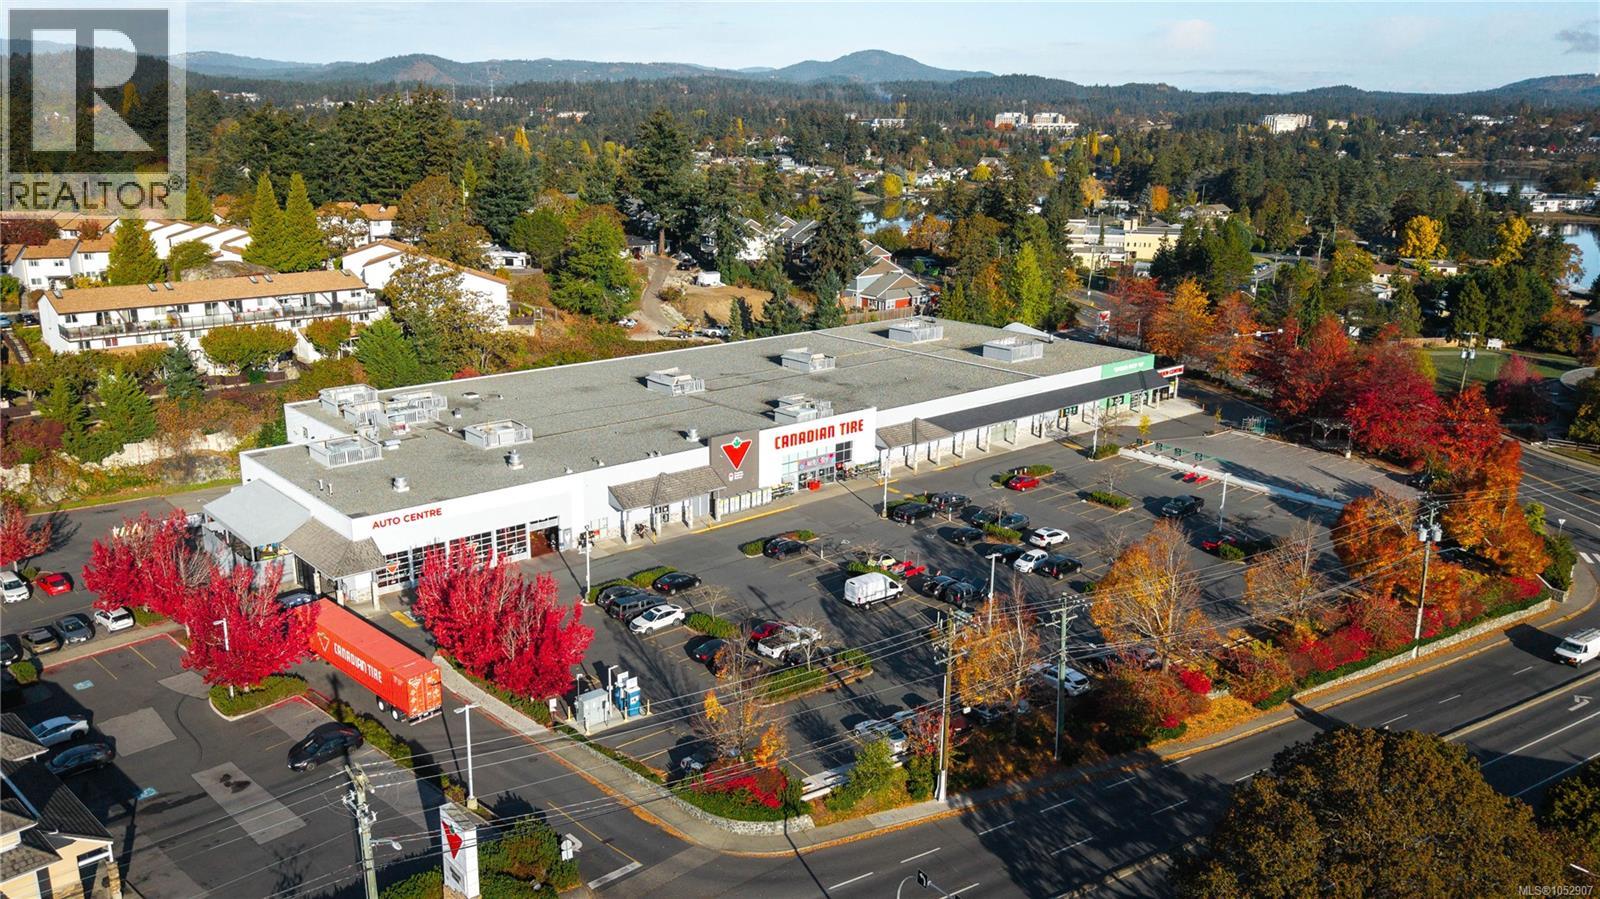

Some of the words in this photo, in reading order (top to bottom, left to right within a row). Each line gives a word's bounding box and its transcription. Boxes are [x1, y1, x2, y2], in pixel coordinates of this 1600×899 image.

[774, 425, 835, 450] CANADIAN
[839, 418, 864, 436] TIRE
[372, 516, 401, 529] AUTO
[403, 507, 442, 523] CENTRE
[333, 642, 367, 674] CANADIAN
[367, 663, 383, 684] TIRE
